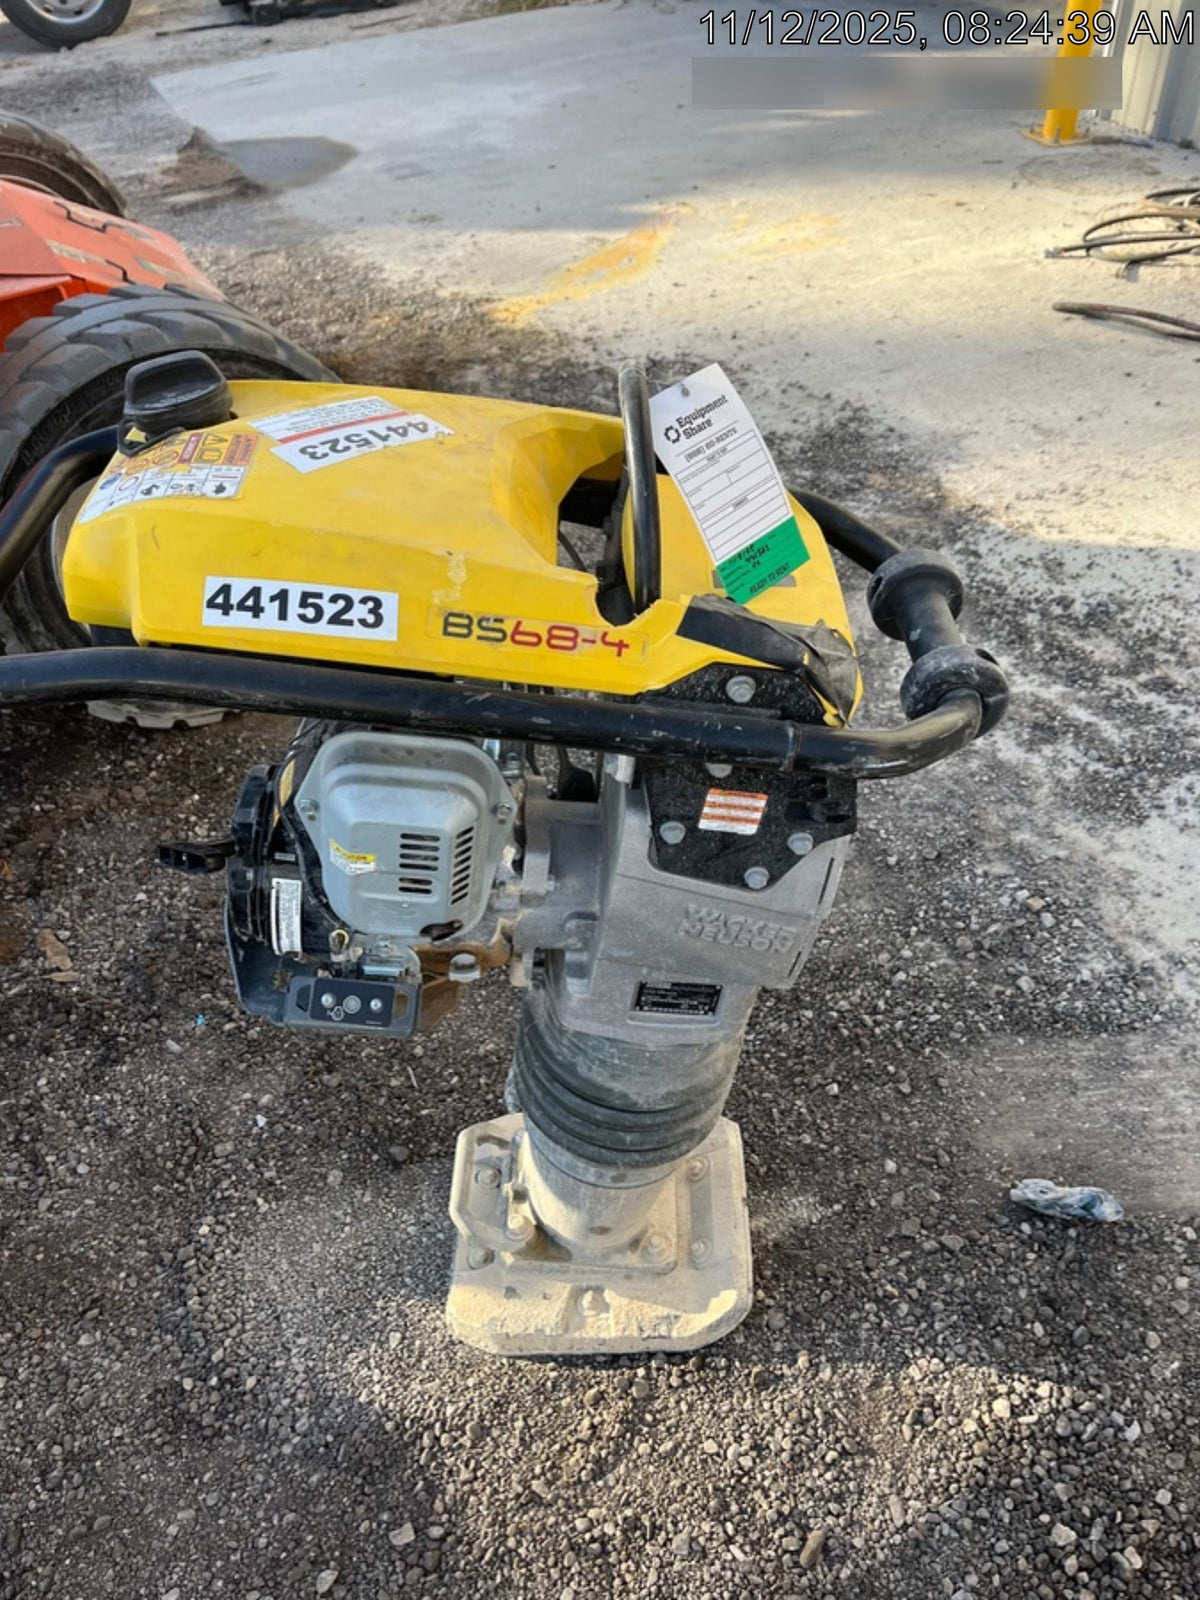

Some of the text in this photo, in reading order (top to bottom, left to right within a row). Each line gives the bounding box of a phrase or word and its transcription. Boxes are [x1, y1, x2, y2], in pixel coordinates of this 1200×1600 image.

[675, 394, 728, 428] Equipment
[682, 418, 714, 440] Share
[298, 420, 430, 461] 441523
[205, 582, 385, 629] 441523
[442, 611, 630, 658] BS68-4
